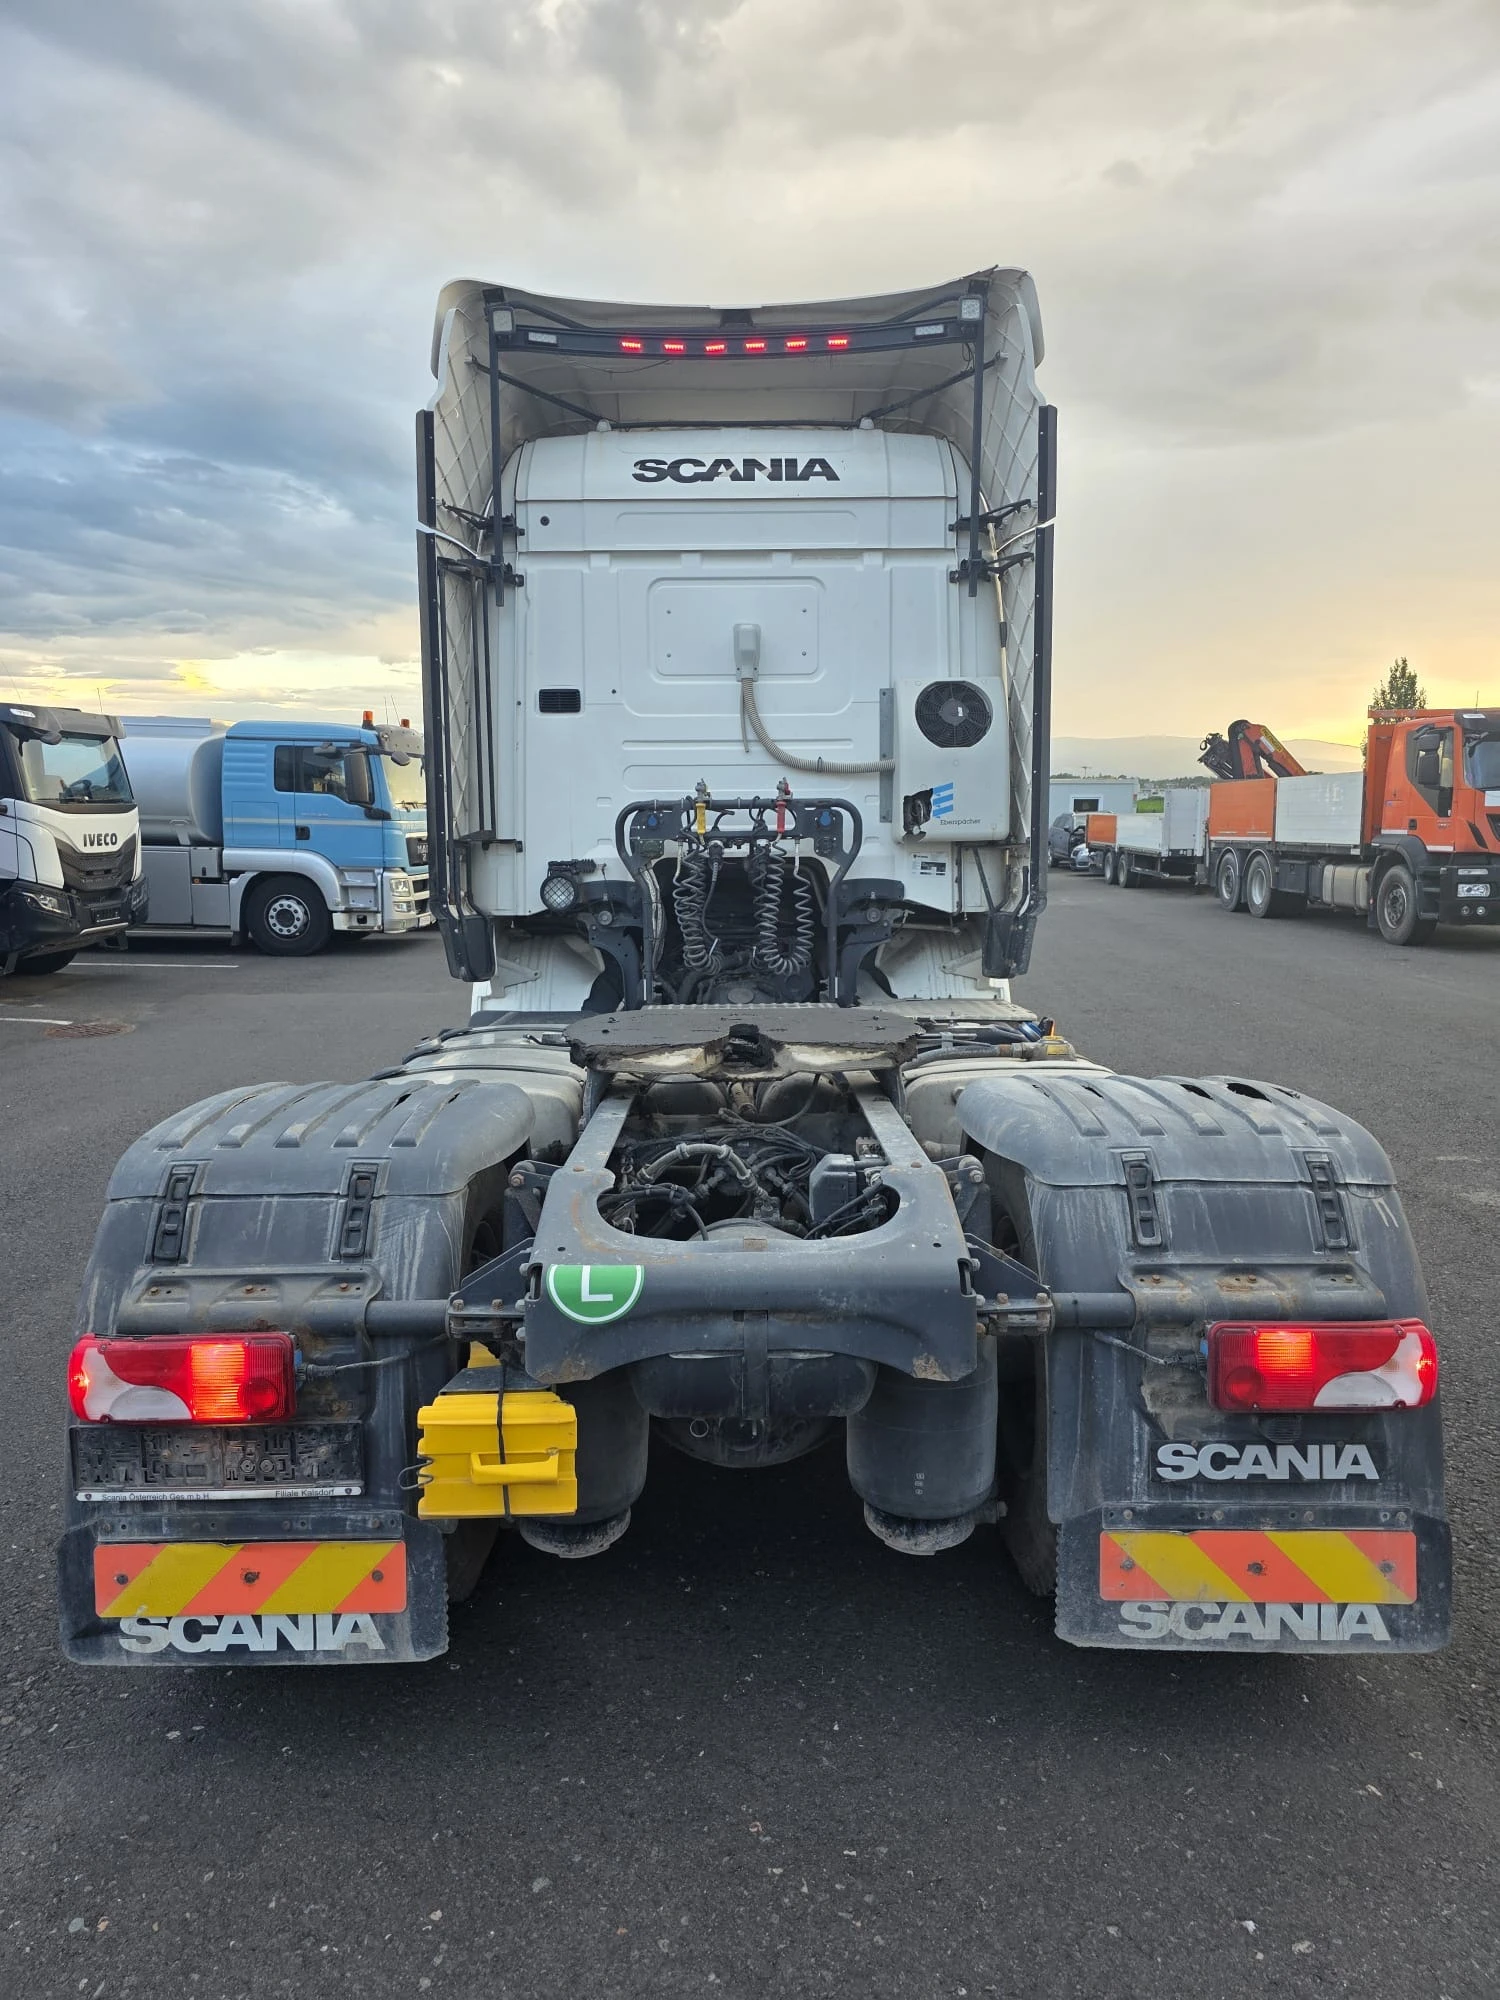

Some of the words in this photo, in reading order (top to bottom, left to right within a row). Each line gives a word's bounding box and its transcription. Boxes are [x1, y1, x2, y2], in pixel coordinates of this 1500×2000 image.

[632, 458, 841, 483] SCANIA
[83, 832, 118, 847] IVECO
[581, 1265, 613, 1302] L
[1156, 1443, 1379, 1480] SCANIA
[119, 1613, 386, 1653] SCANIA
[1118, 1601, 1391, 1641] SCANIA
